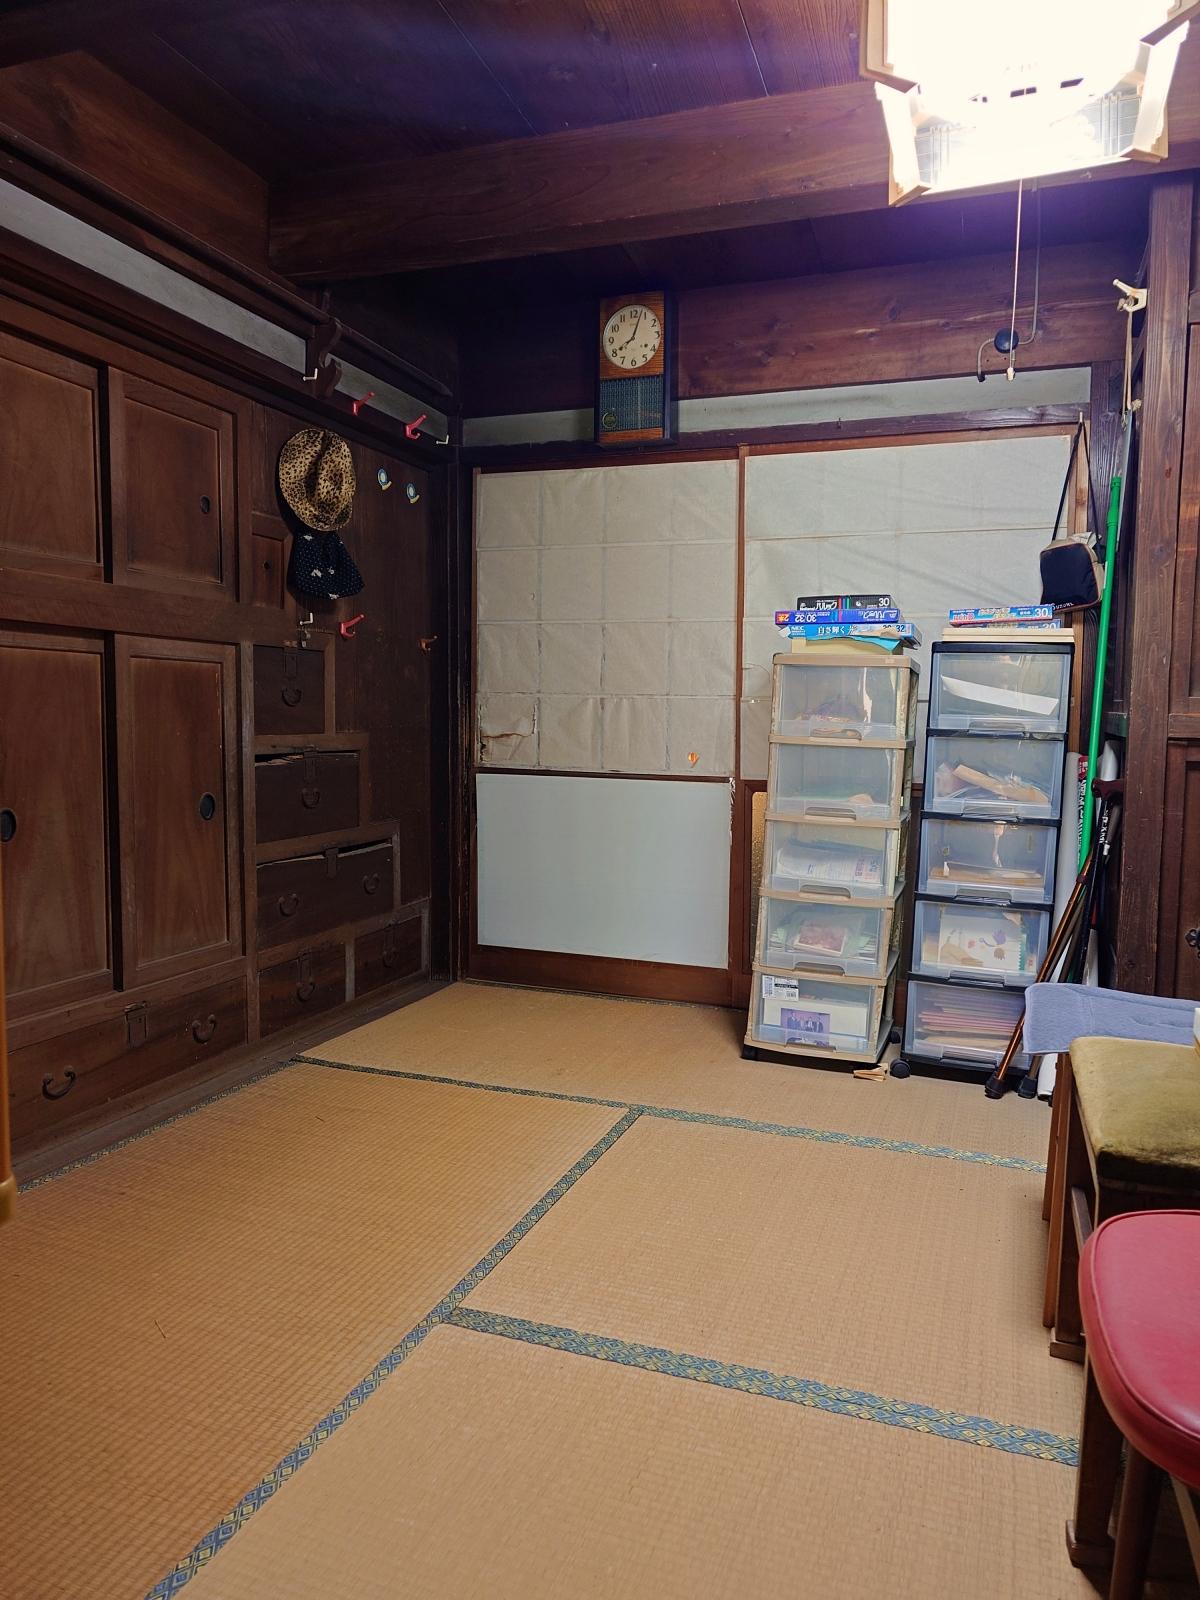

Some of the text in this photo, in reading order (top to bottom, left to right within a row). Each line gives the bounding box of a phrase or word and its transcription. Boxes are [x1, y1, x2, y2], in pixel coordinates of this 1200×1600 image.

[620, 314, 626, 323] 11
[630, 309, 639, 319] 12
[643, 311, 647, 320] 1
[650, 318, 657, 328] 2
[611, 323, 620, 333] 10
[654, 330, 661, 339] 3
[608, 336, 615, 345] 9
[650, 343, 656, 353] 4
[611, 348, 618, 358] 8
[641, 353, 648, 362] 5
[619, 356, 626, 365] 7
[630, 359, 637, 367] 6
[878, 597, 890, 607] 30
[1034, 607, 1049, 618] 30
[895, 624, 905, 633] 32
